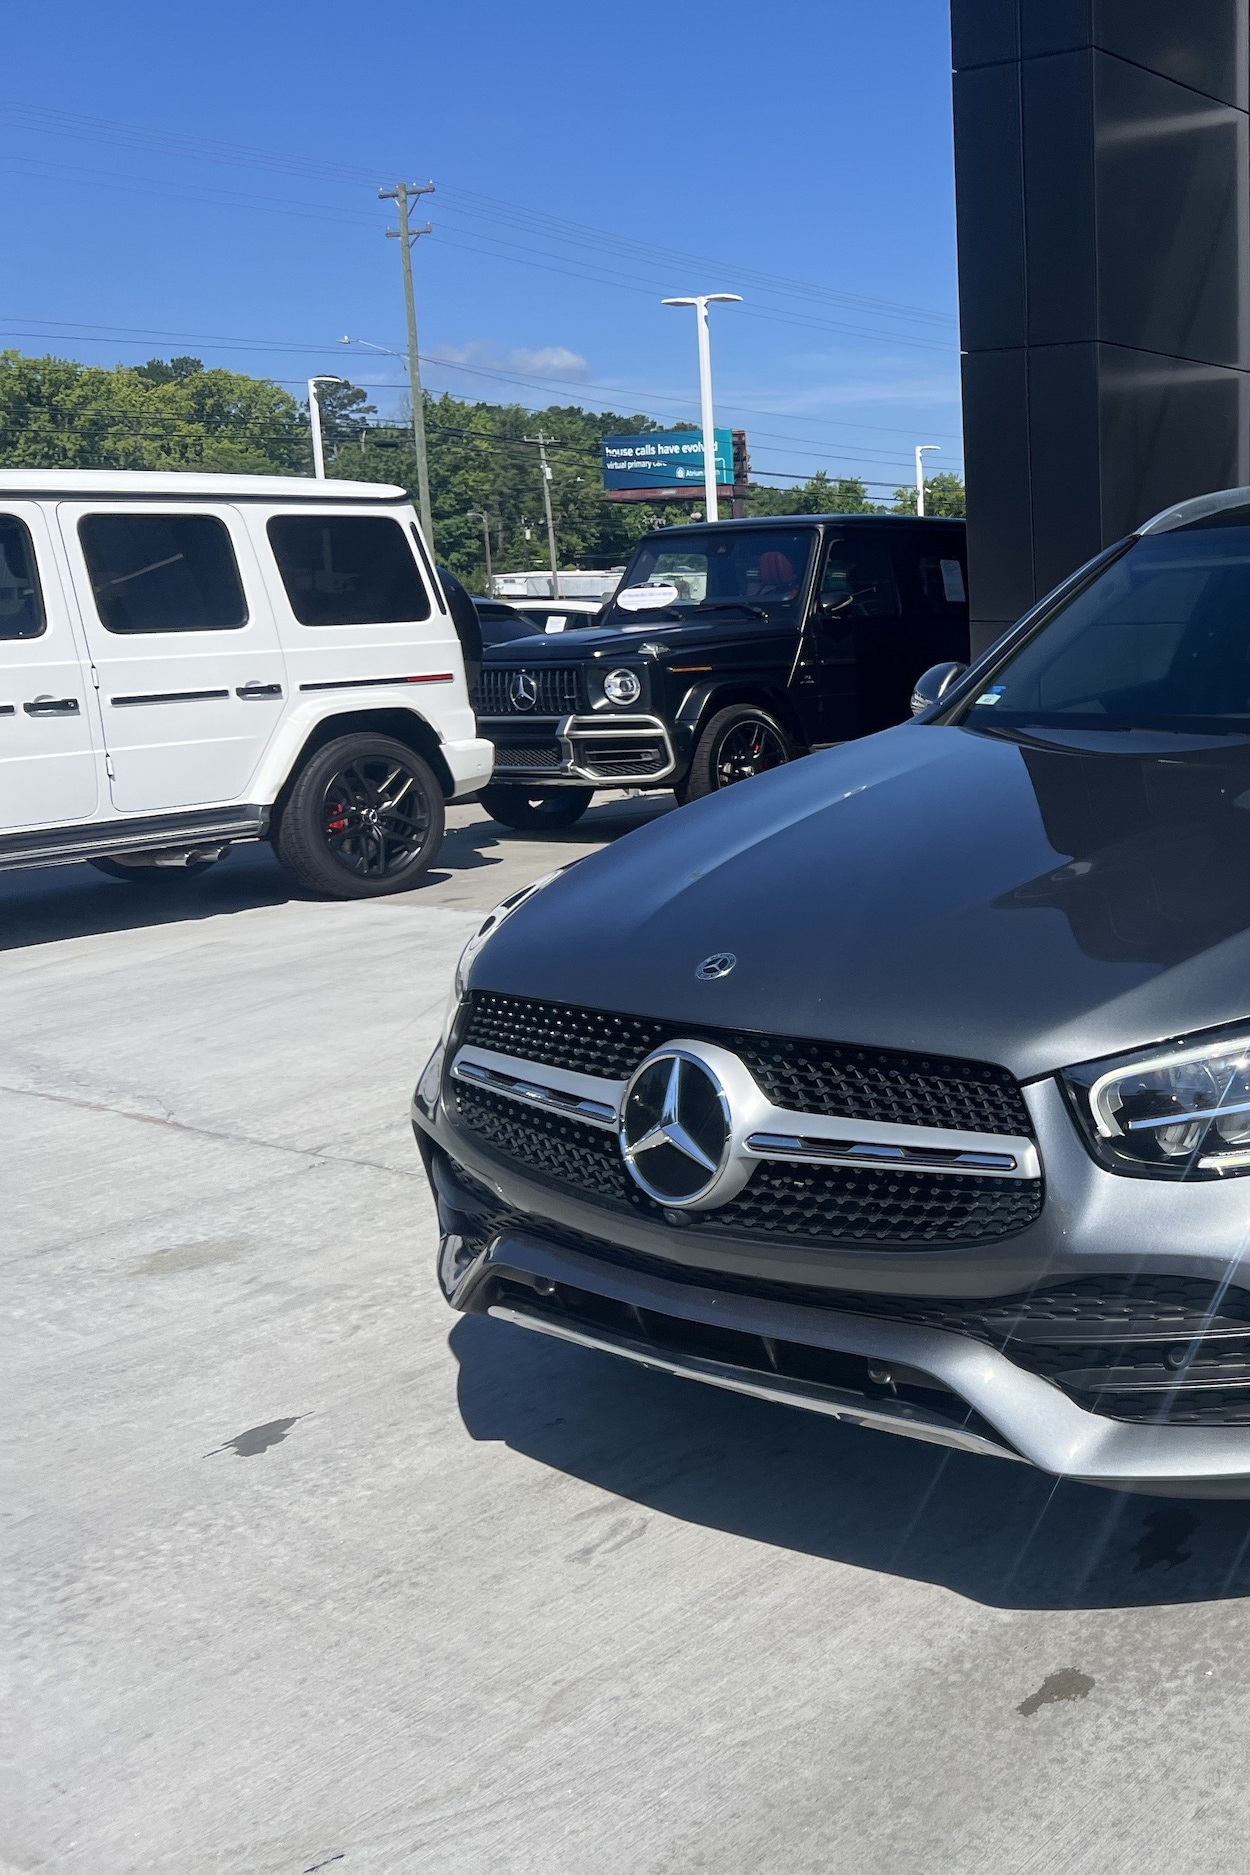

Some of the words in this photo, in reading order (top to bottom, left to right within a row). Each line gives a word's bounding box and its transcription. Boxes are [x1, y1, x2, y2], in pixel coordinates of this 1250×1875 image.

[605, 447, 634, 457] house
[635, 444, 656, 456] calls
[657, 443, 680, 455] have
[681, 441, 718, 453] evolvd
[606, 460, 627, 470] virtual
[627, 460, 652, 470] primary
